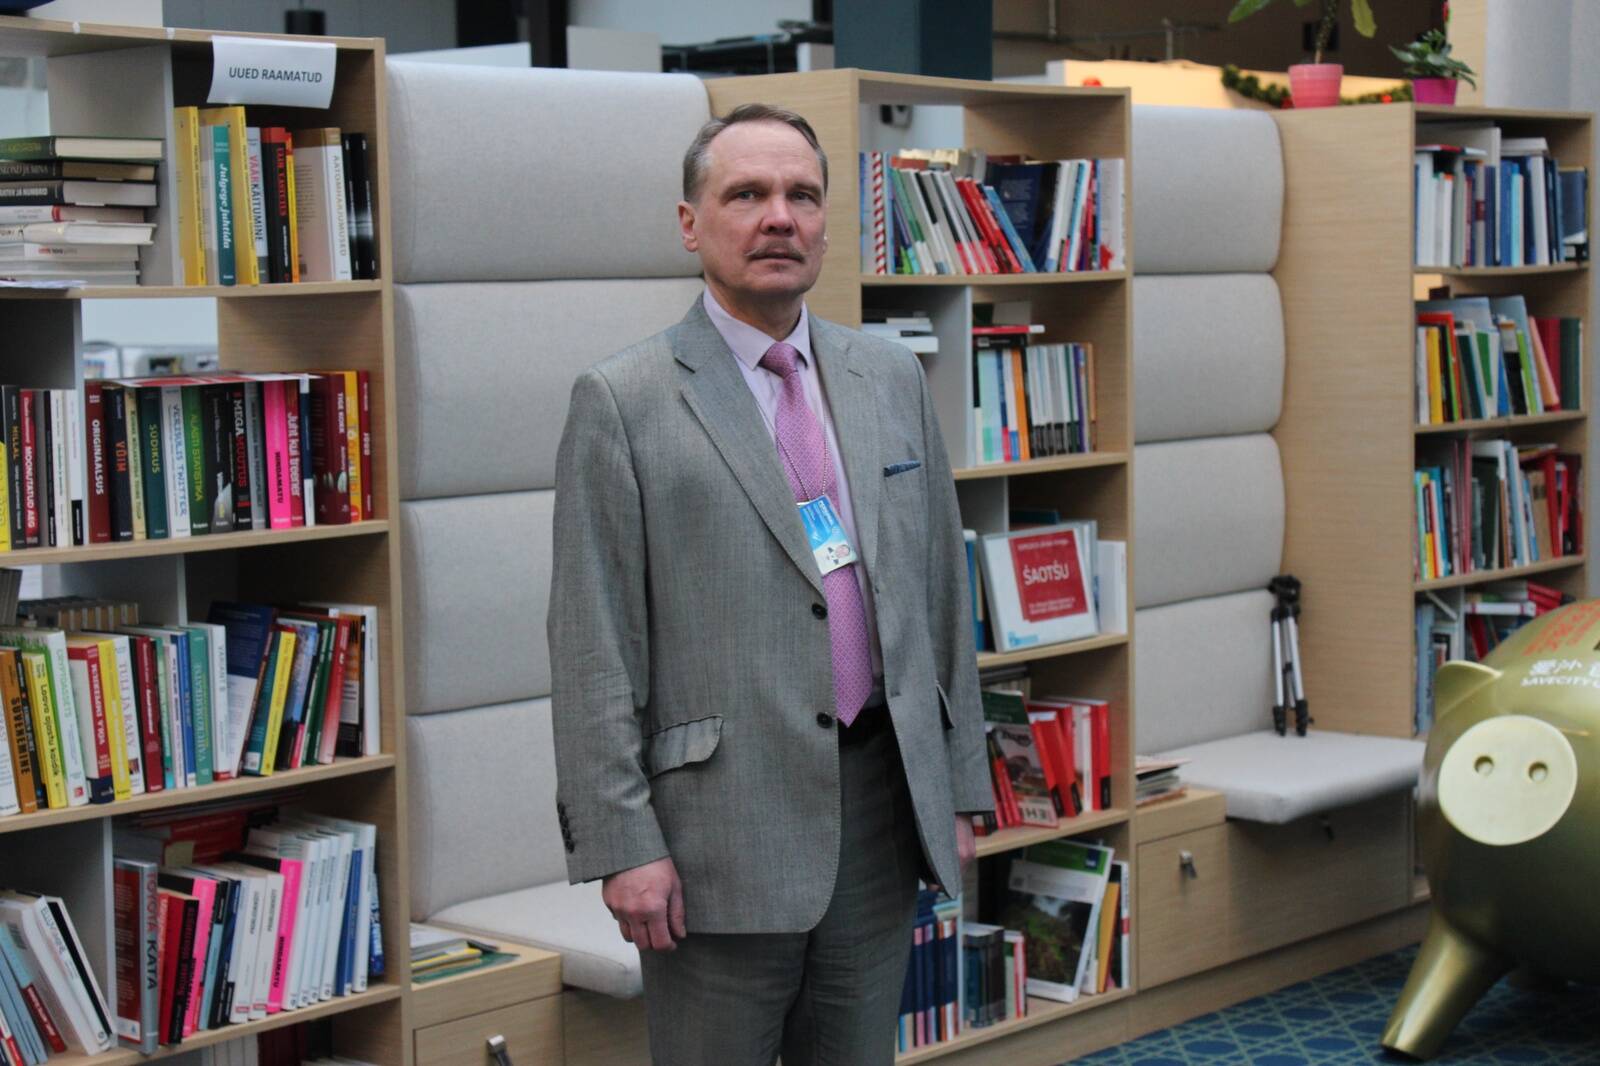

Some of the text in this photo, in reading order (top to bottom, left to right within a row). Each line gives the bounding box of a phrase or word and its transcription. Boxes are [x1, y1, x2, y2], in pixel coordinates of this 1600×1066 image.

[229, 67, 322, 83] UUED RAAMATUD
[219, 206, 232, 249] juhtida
[12, 425, 20, 461] MILLAL
[92, 419, 104, 496] ORIGINAALSUS
[115, 441, 128, 472] VÕIM
[287, 412, 301, 497] Juht kui treener
[25, 445, 37, 529] MOONUTATUD AEG
[56, 648, 72, 719] CRYPTOASSETS
[119, 662, 131, 691] TULI
[124, 713, 138, 749] RAEV
[146, 871, 158, 991] TOYOTA KATA
